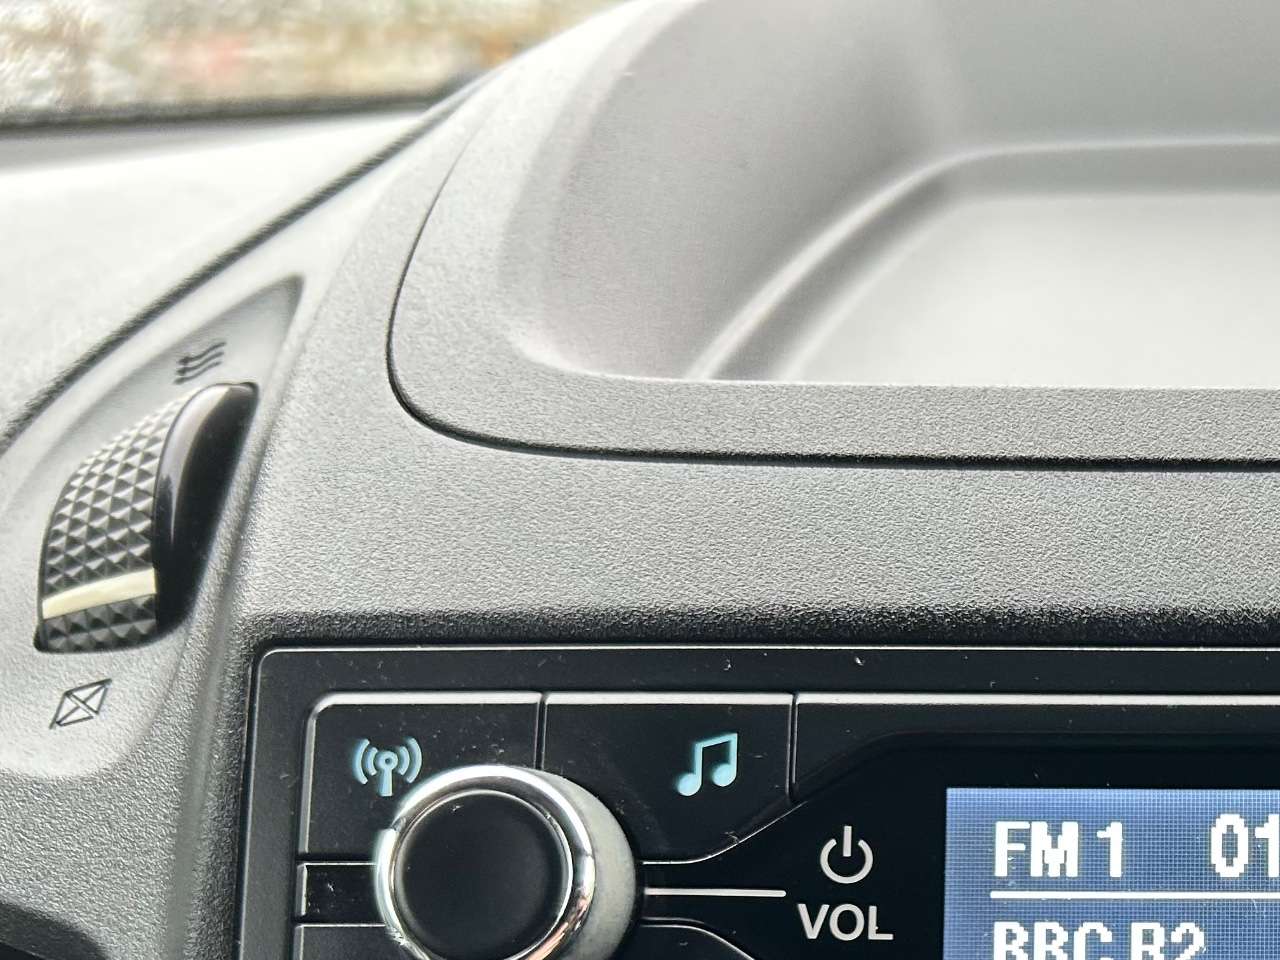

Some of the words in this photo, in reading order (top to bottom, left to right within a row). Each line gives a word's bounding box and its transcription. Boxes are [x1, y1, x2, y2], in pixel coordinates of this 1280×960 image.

[993, 820, 1079, 879] FM
[1099, 821, 1125, 878] 1
[797, 903, 894, 941] VOL
